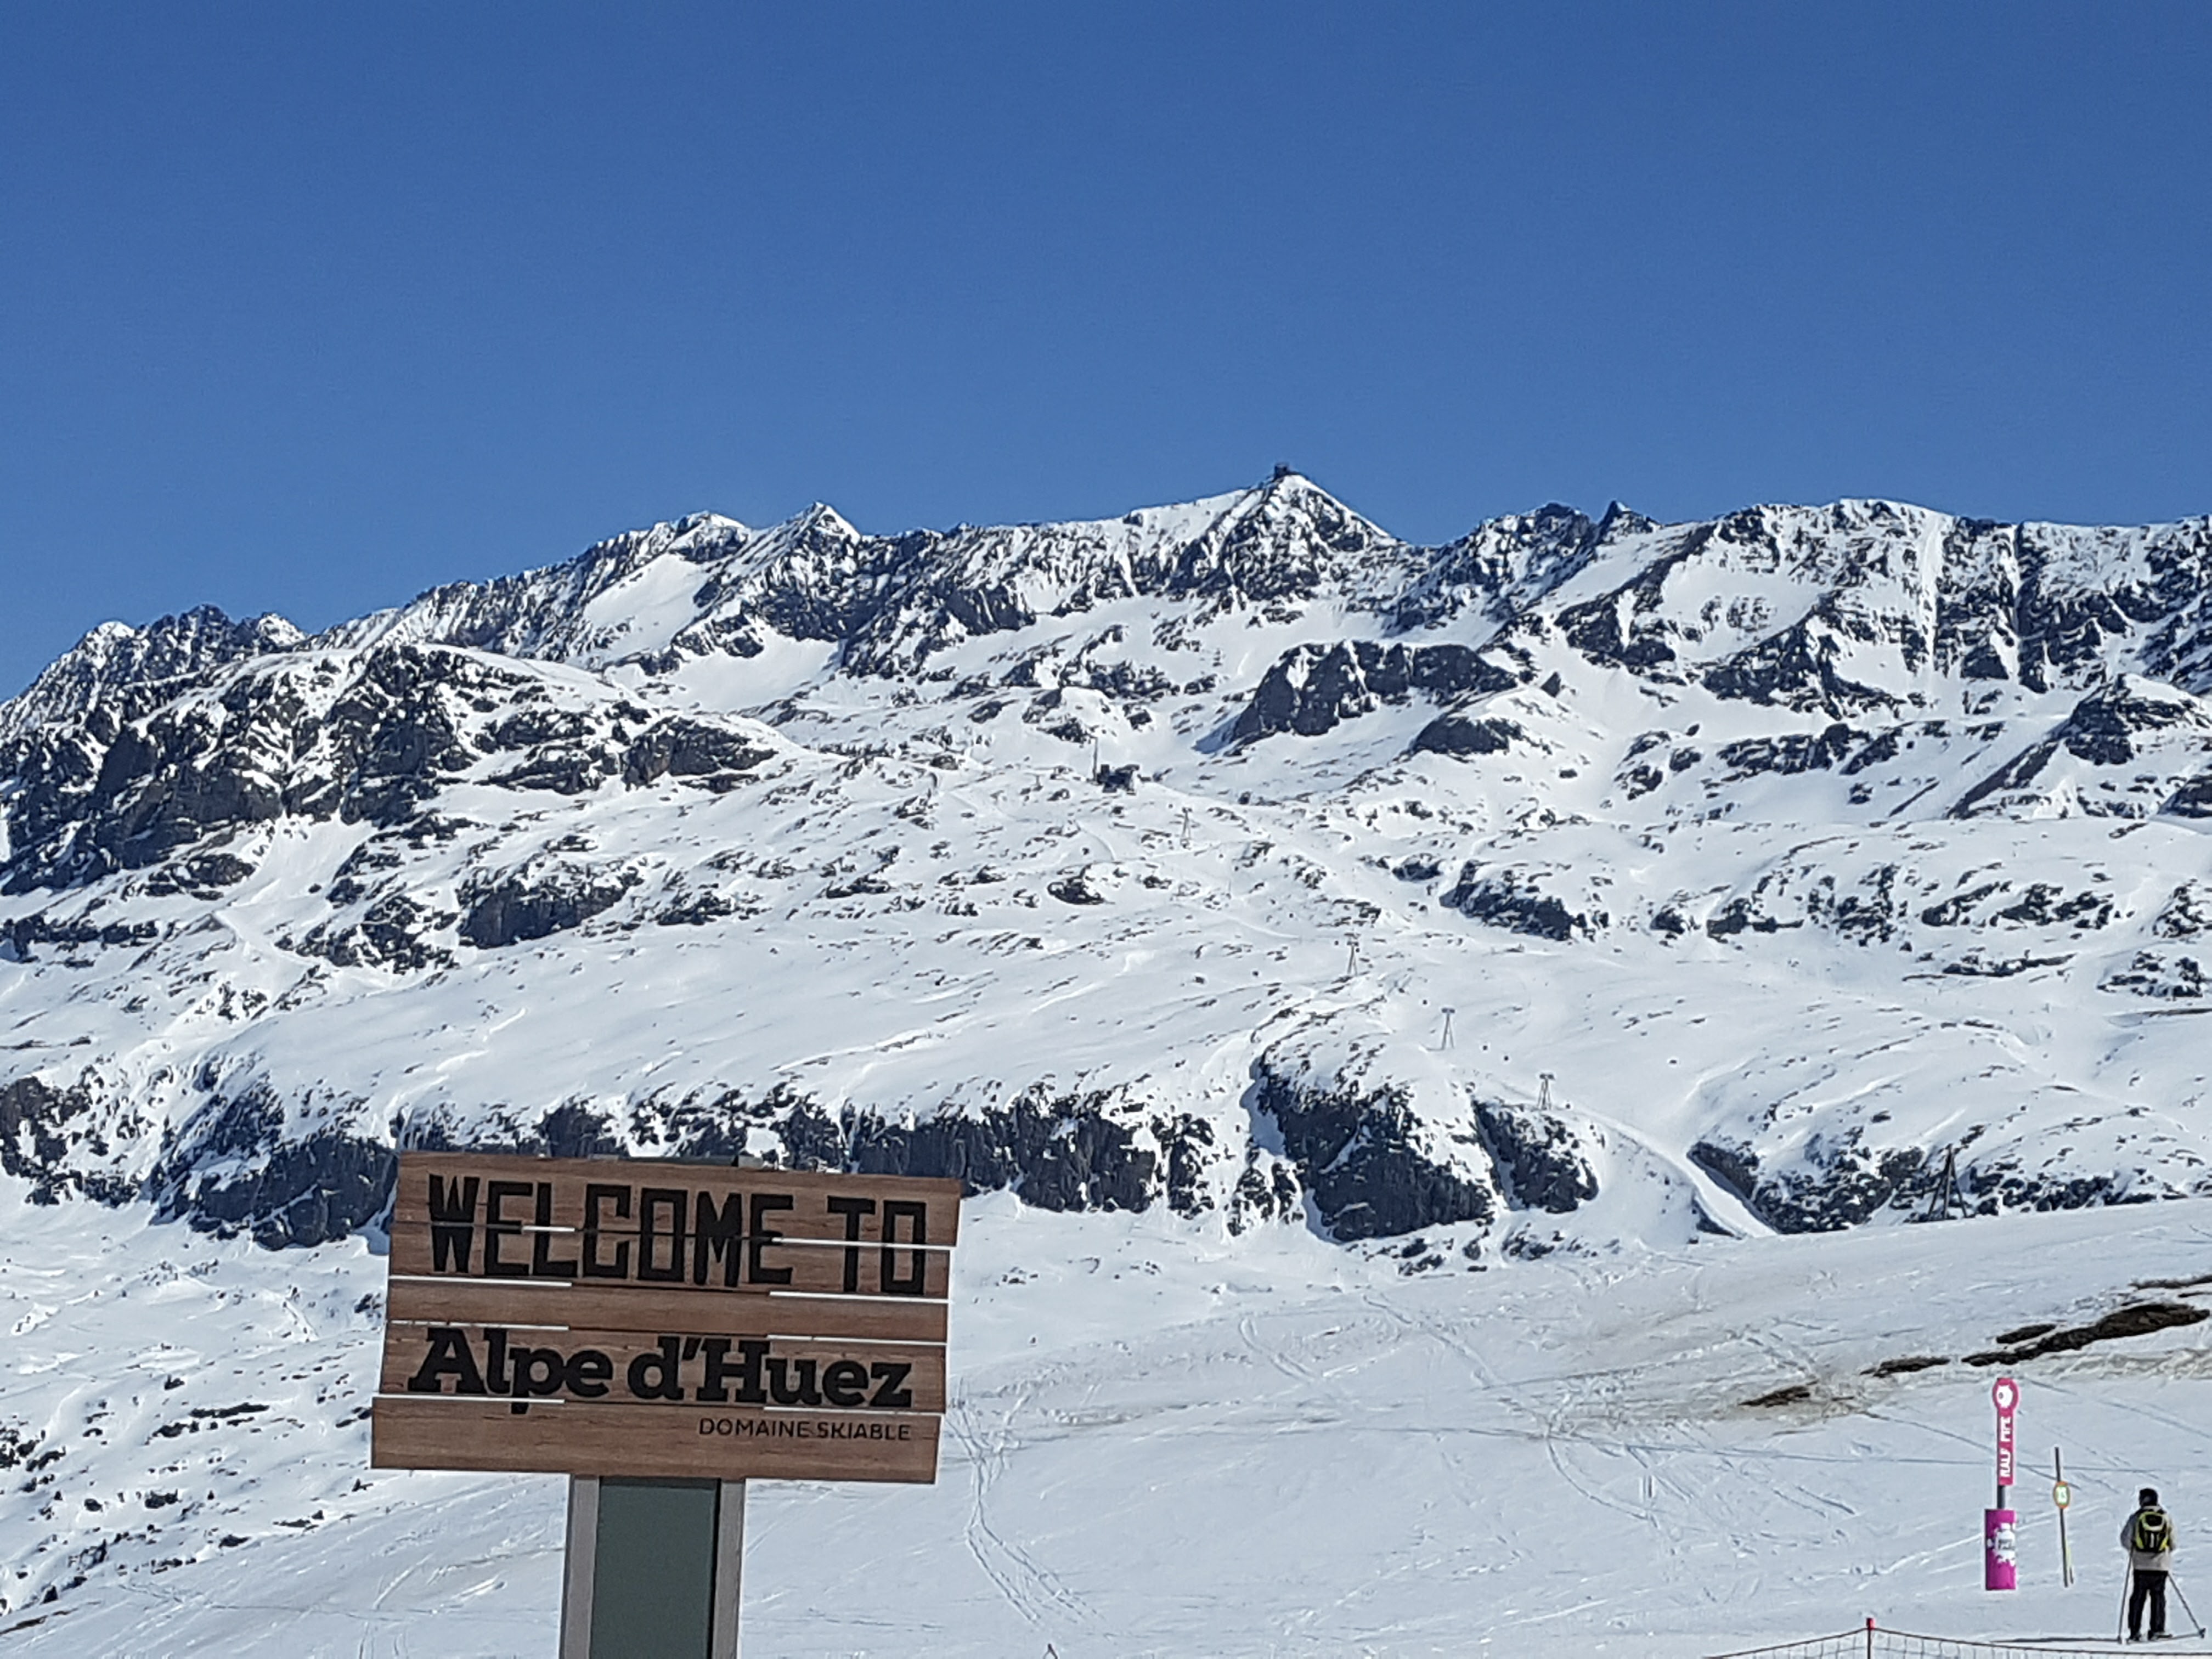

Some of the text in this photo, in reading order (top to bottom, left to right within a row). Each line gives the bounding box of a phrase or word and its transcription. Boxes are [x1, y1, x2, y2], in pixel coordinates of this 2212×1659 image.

[428, 1174, 927, 1295] WELCOME TO
[408, 1327, 912, 1414] Alpe d'Huez
[698, 1418, 911, 1441] DOMAINE SKIABLE
